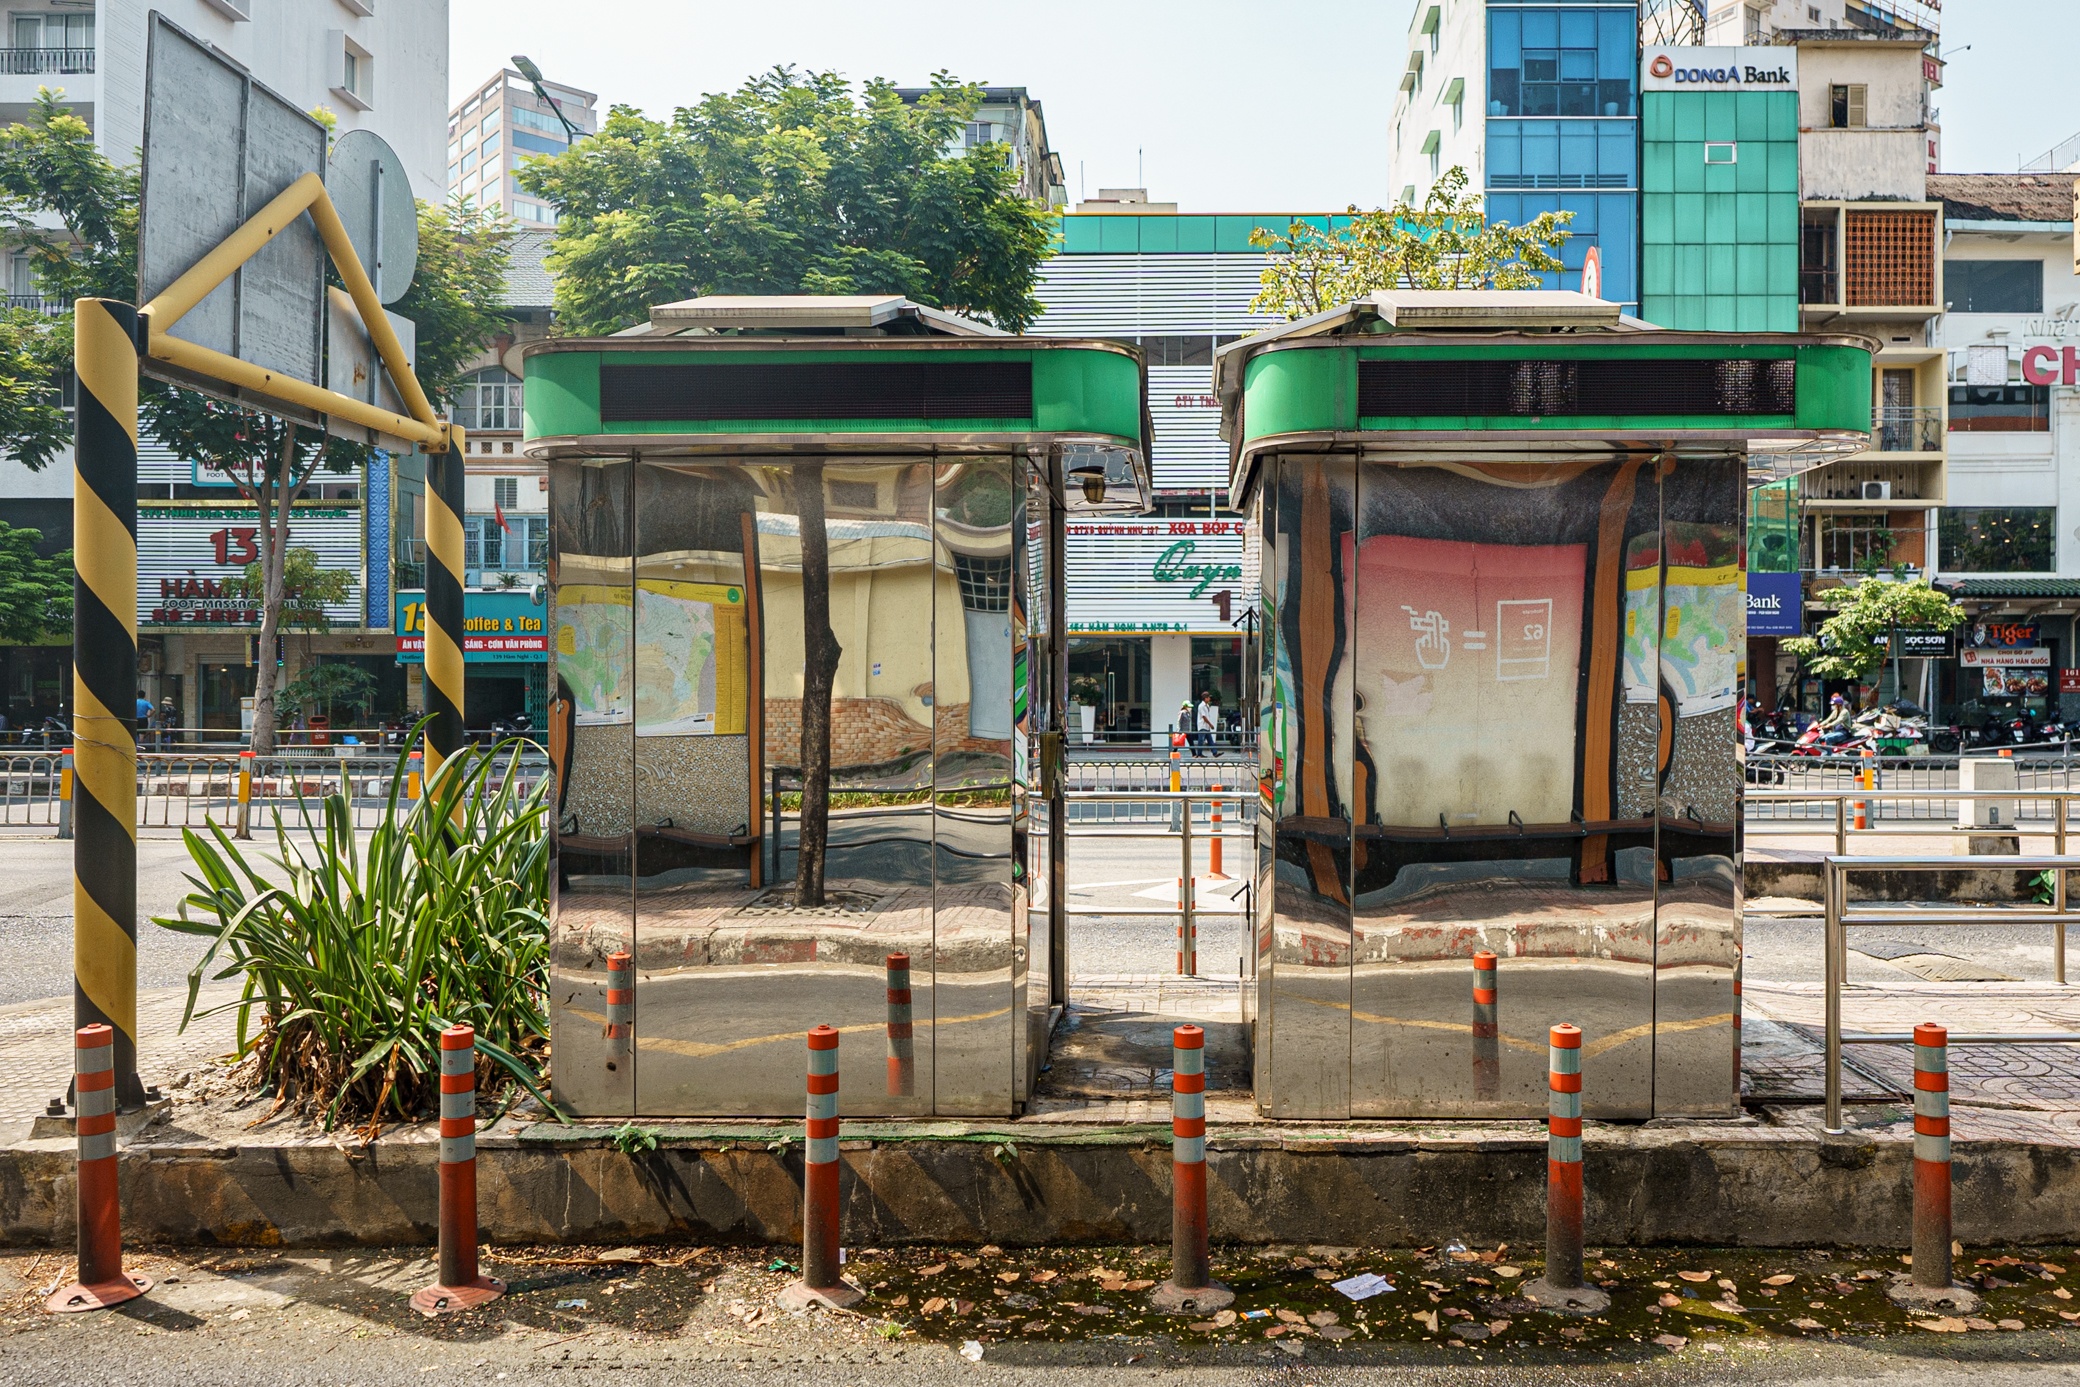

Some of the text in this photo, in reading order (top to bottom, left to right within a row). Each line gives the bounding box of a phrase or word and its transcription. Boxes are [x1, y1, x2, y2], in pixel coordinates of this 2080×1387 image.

[1675, 66, 1790, 83] DONGA Bank
[1175, 395, 1194, 408] CTY
[141, 510, 161, 518] CTY
[164, 510, 196, 518] TNHH
[1168, 522, 1197, 535] XOA
[1202, 518, 1230, 535] BÓP
[162, 599, 196, 609] FOOT
[1212, 590, 1238, 621] 1
[1747, 594, 1781, 608] Bank
[463, 616, 499, 631] offee
[504, 618, 514, 631] &
[519, 616, 541, 631] Tea
[1088, 620, 1109, 632] HÀM
[1114, 622, 1136, 632] NGHI
[1925, 635, 1946, 644] SƠN
[1989, 622, 2034, 646] Tiger
[464, 639, 483, 649] SÁNG
[488, 639, 503, 649] CƠM
[505, 639, 519, 649] VĂN
[520, 638, 543, 649] PHÒNG
[2031, 656, 2049, 664] QUỐC
